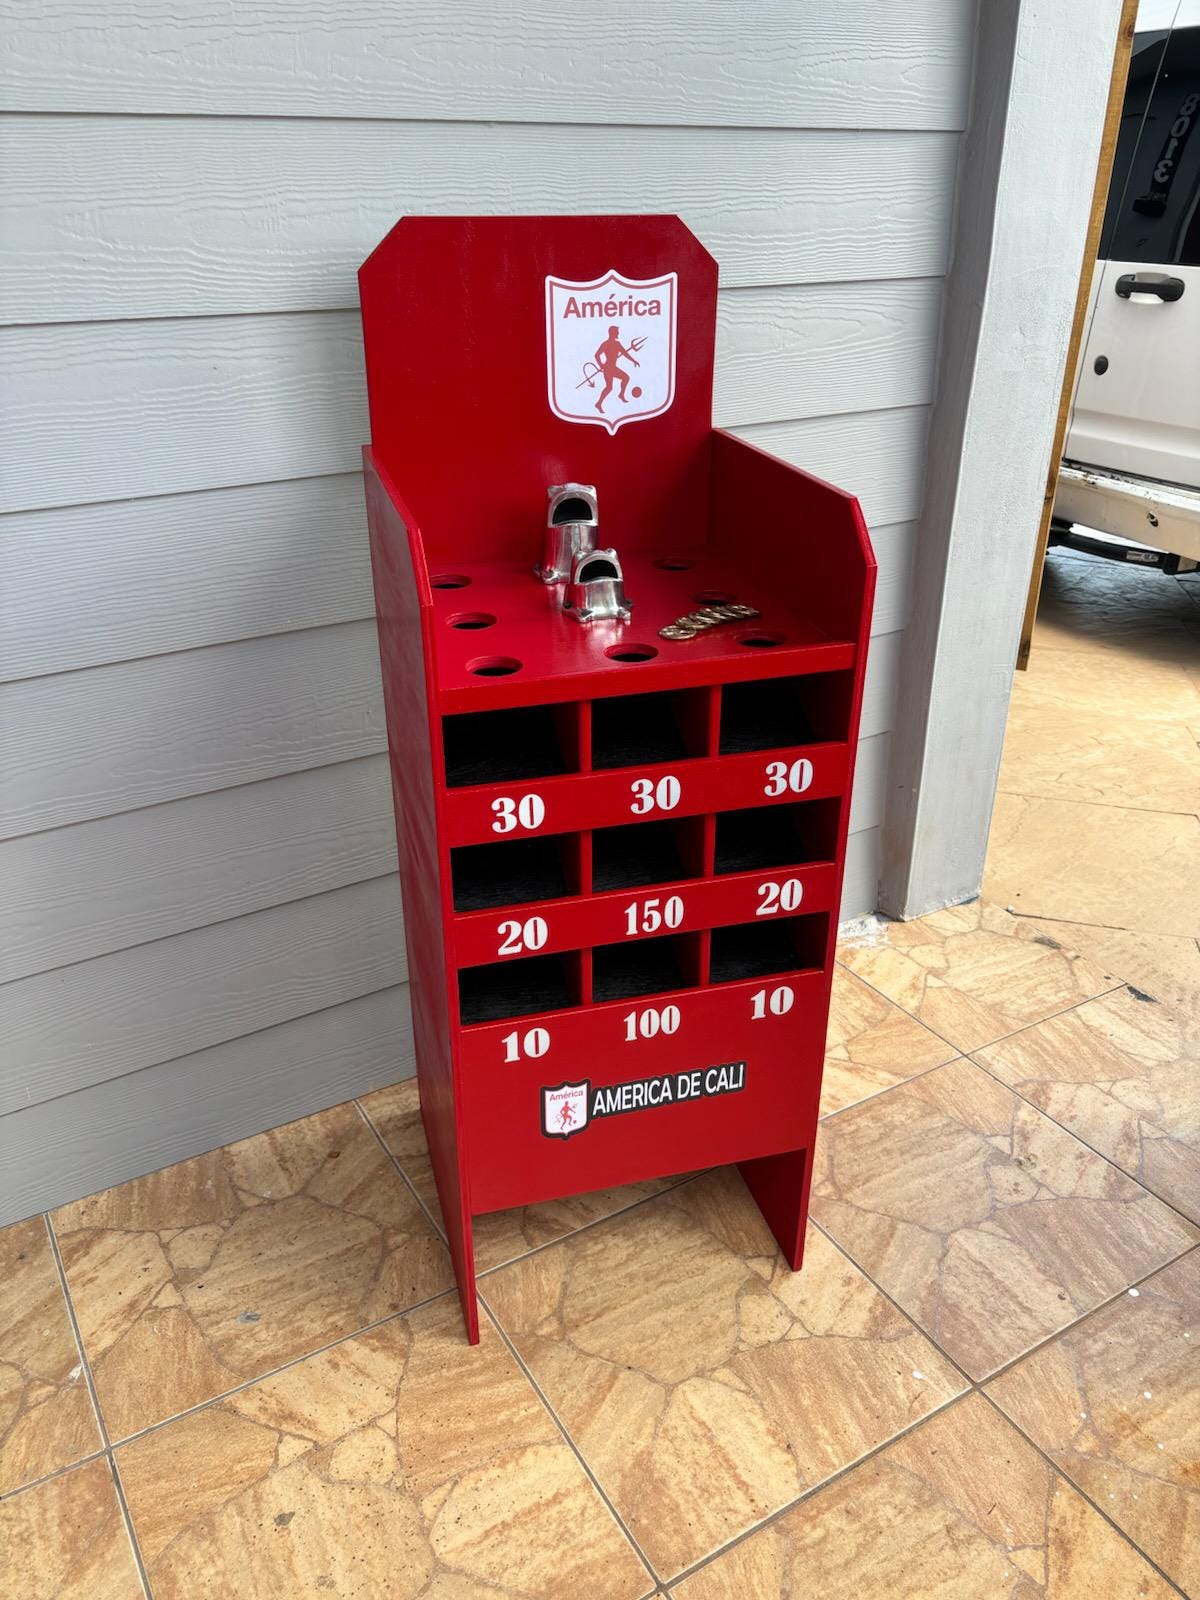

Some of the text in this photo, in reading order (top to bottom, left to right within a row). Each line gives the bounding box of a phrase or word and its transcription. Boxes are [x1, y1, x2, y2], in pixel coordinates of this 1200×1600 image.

[563, 293, 661, 319] América
[491, 758, 814, 834] 30 30 30
[497, 878, 804, 956] 20 150 20
[501, 985, 795, 1063] 10 100 10
[550, 1089, 584, 1101] América
[592, 1063, 745, 1116] AMERICA DE CALI
